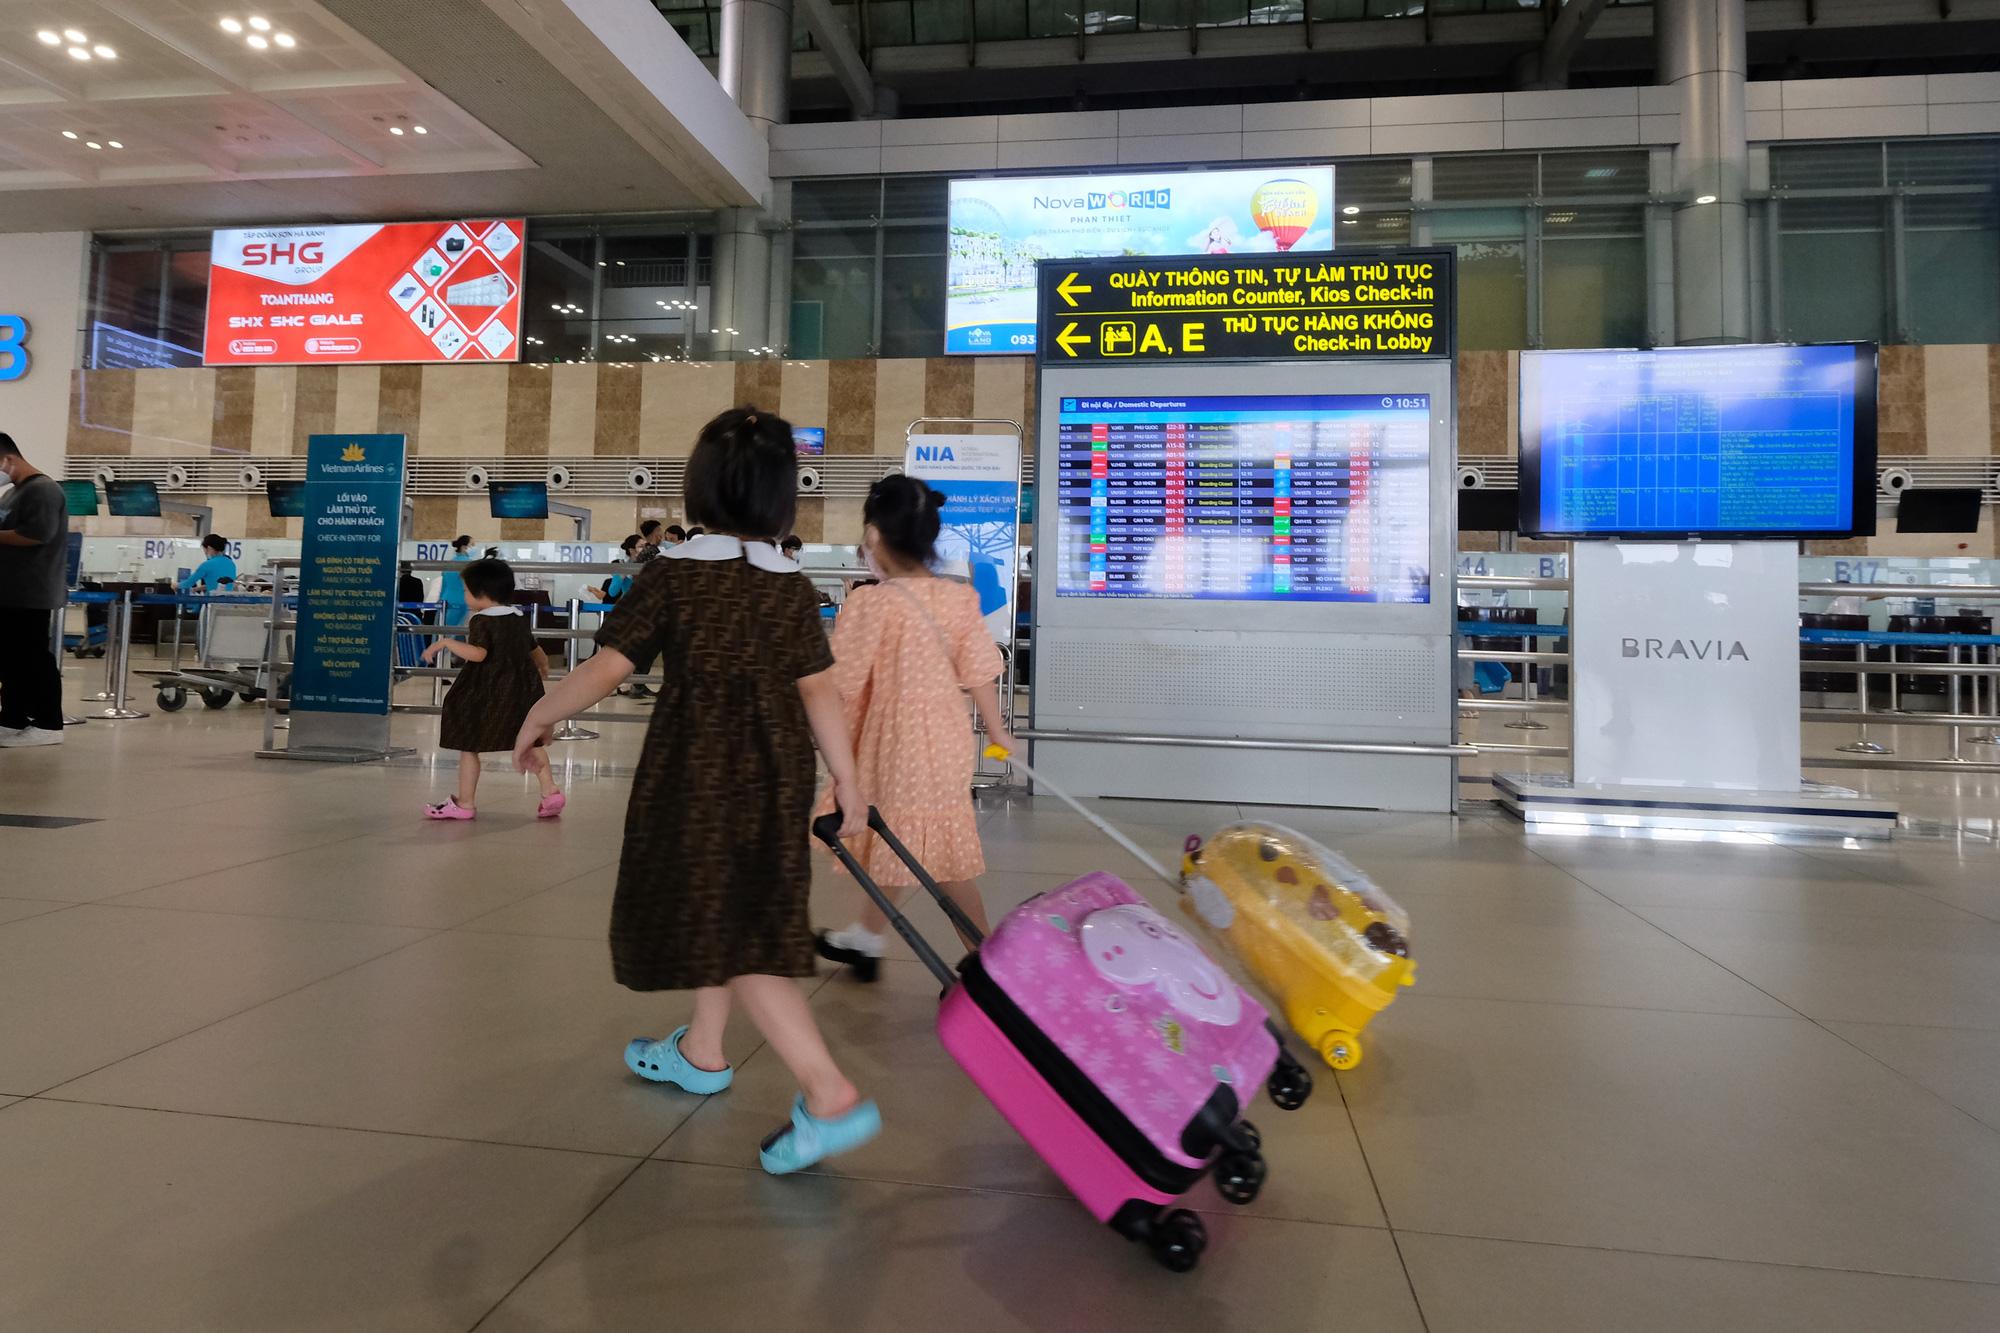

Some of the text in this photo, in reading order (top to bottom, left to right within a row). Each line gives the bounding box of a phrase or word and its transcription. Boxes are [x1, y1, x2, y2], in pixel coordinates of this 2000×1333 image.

[242, 242, 324, 266] SHG
[295, 266, 324, 274] GROUP
[1110, 261, 1433, 288] QUÀY THÔNG TIN, TỰ LÀM THỦ TỤC
[1132, 283, 1434, 308] Information Counter, Kios Check-in
[229, 316, 263, 328] SHX
[270, 316, 305, 327] SHC
[1223, 309, 1434, 336] THỦ TỤC HÀNG KHÔNG
[0, 314, 27, 380] B
[1011, 334, 1036, 344] 093
[1140, 323, 1206, 356] A, E
[1294, 332, 1433, 353] Check-in Lobby
[1396, 398, 1426, 408] 10:51
[916, 446, 954, 462] NIA
[317, 518, 334, 526] CHO
[348, 534, 367, 542] ENTRY
[368, 534, 382, 543] FOR
[417, 544, 448, 560] B07
[560, 545, 592, 562] B08
[1457, 557, 1486, 576] 14
[1540, 558, 1567, 578] B1
[1834, 561, 1880, 584] B17
[1621, 638, 1750, 662] BRAVIA
